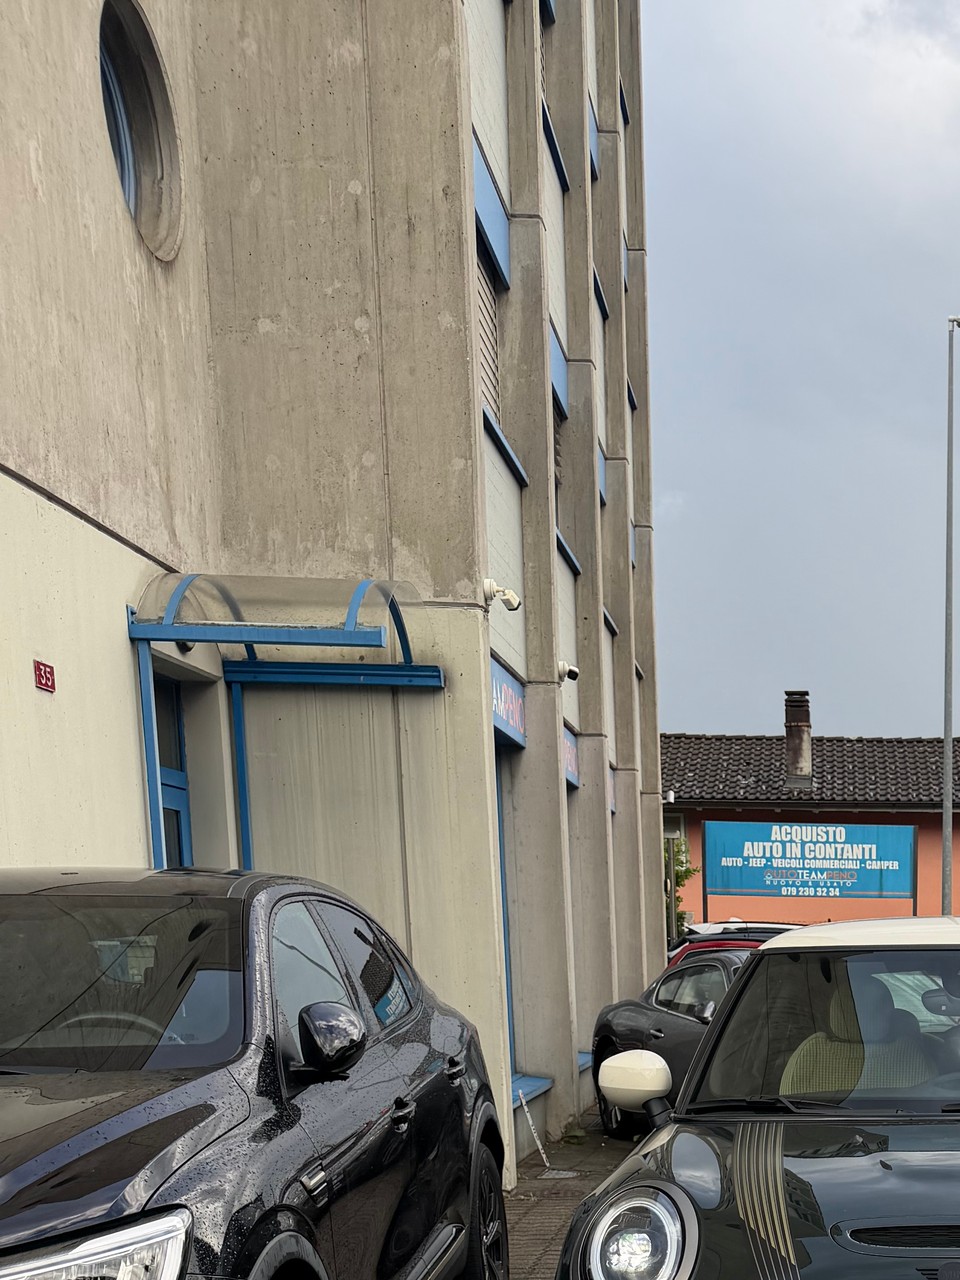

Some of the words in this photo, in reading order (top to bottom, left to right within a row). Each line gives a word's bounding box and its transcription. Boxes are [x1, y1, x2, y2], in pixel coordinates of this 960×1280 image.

[40, 665, 51, 686] 35
[770, 825, 846, 842] ACQUISTO
[743, 842, 782, 857] AUTO
[785, 843, 801, 858] IN
[804, 843, 877, 859] CONTANTI
[721, 857, 743, 866] AUTO
[749, 858, 766, 867] JEEP
[772, 859, 803, 868] VEICOLI
[804, 859, 860, 869] COMMERCIALI
[866, 860, 899, 870] CAMPER
[781, 887, 797, 895] 079
[798, 887, 814, 896] 230
[816, 887, 827, 896] 32
[829, 888, 840, 896] 34
